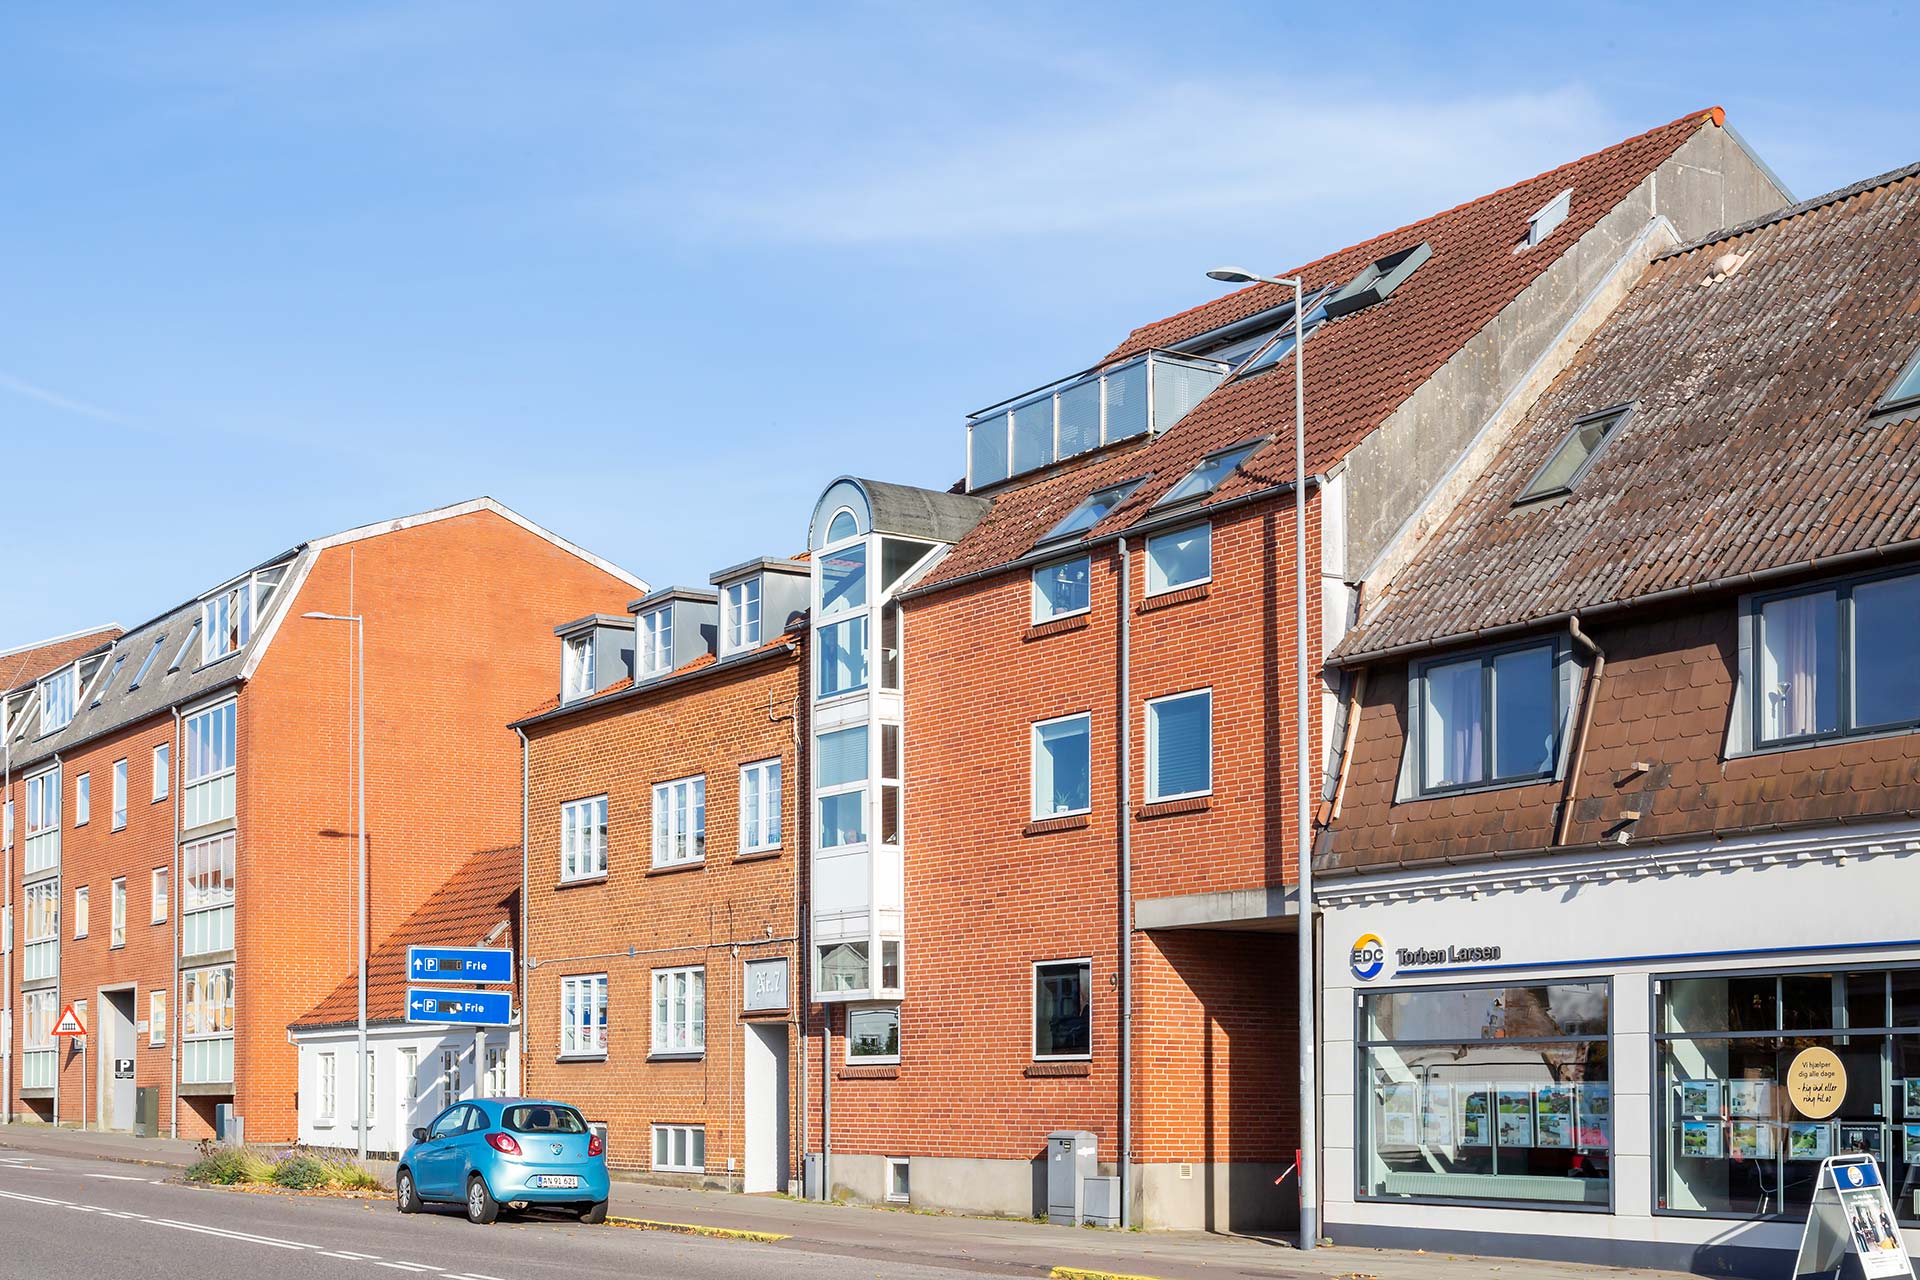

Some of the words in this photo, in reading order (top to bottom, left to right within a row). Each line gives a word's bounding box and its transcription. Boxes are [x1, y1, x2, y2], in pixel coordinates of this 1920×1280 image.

[1353, 949, 1384, 963] EDC
[1396, 947, 1446, 966] Torben
[1448, 945, 1501, 964] Larsen
[427, 960, 435, 970] P
[466, 961, 488, 971] Frie
[1110, 973, 1117, 992] 9
[426, 1001, 434, 1010] P
[465, 1003, 485, 1013] Frie
[120, 1059, 131, 1073] P
[1809, 1061, 1831, 1070] hjælper
[1820, 1070, 1836, 1078] dage
[1824, 1083, 1838, 1092] eller
[1803, 1095, 1816, 1107] ring
[1817, 1093, 1825, 1103] til
